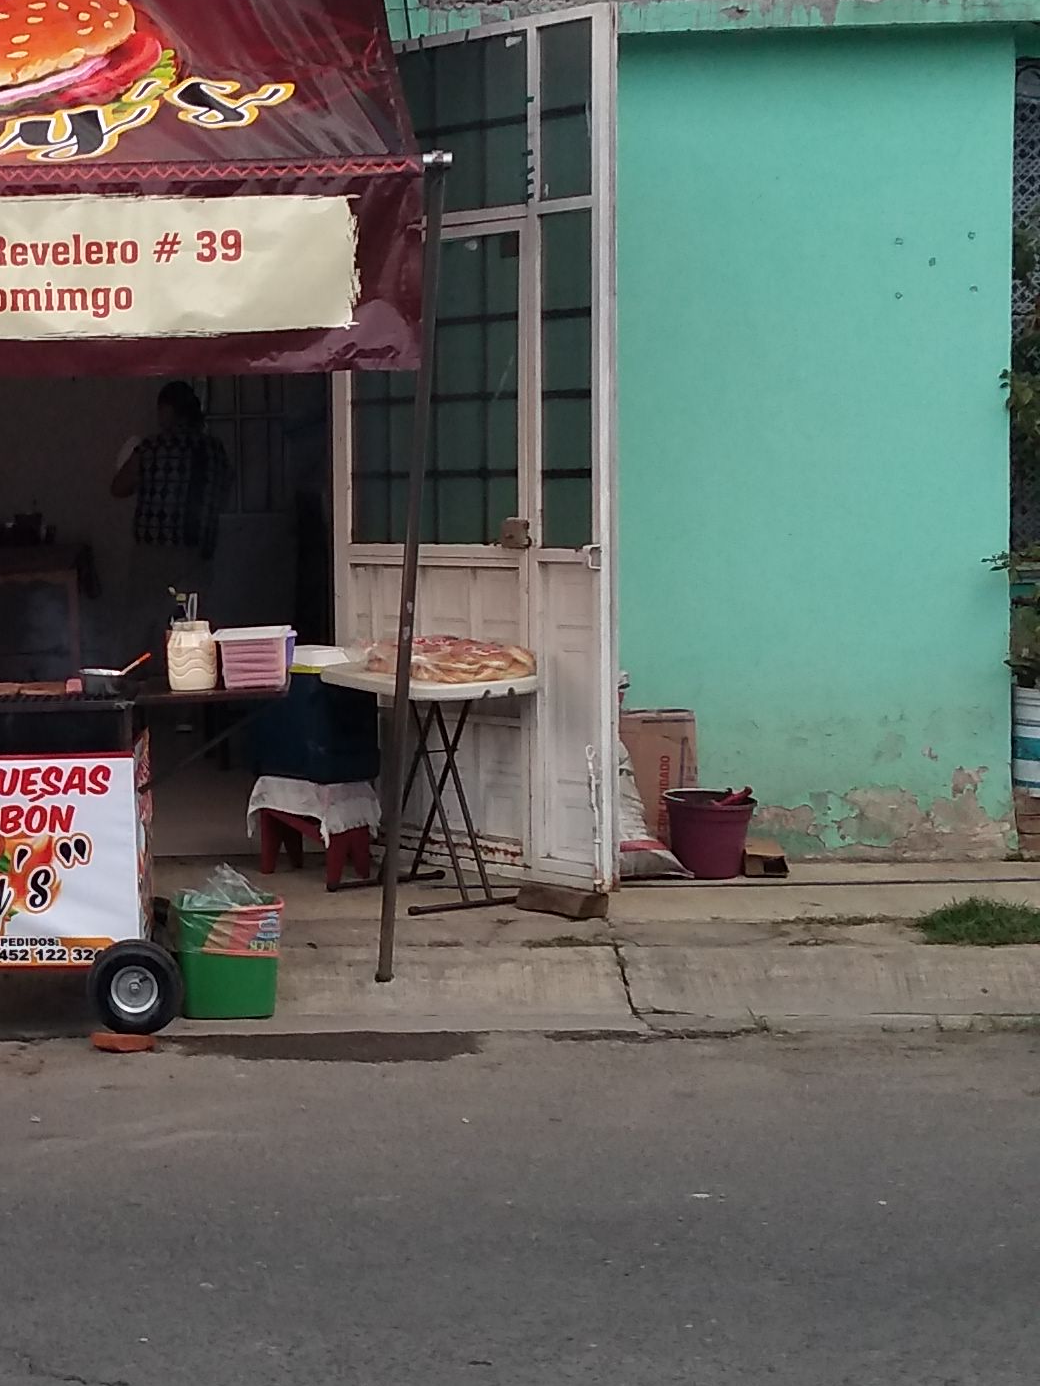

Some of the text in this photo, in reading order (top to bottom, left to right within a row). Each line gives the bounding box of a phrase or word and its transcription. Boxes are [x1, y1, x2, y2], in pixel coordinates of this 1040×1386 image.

[153, 231, 181, 263] #
[196, 229, 242, 263] 39
[0, 938, 59, 947] PEDIDOS:
[35, 949, 67, 961] 122
